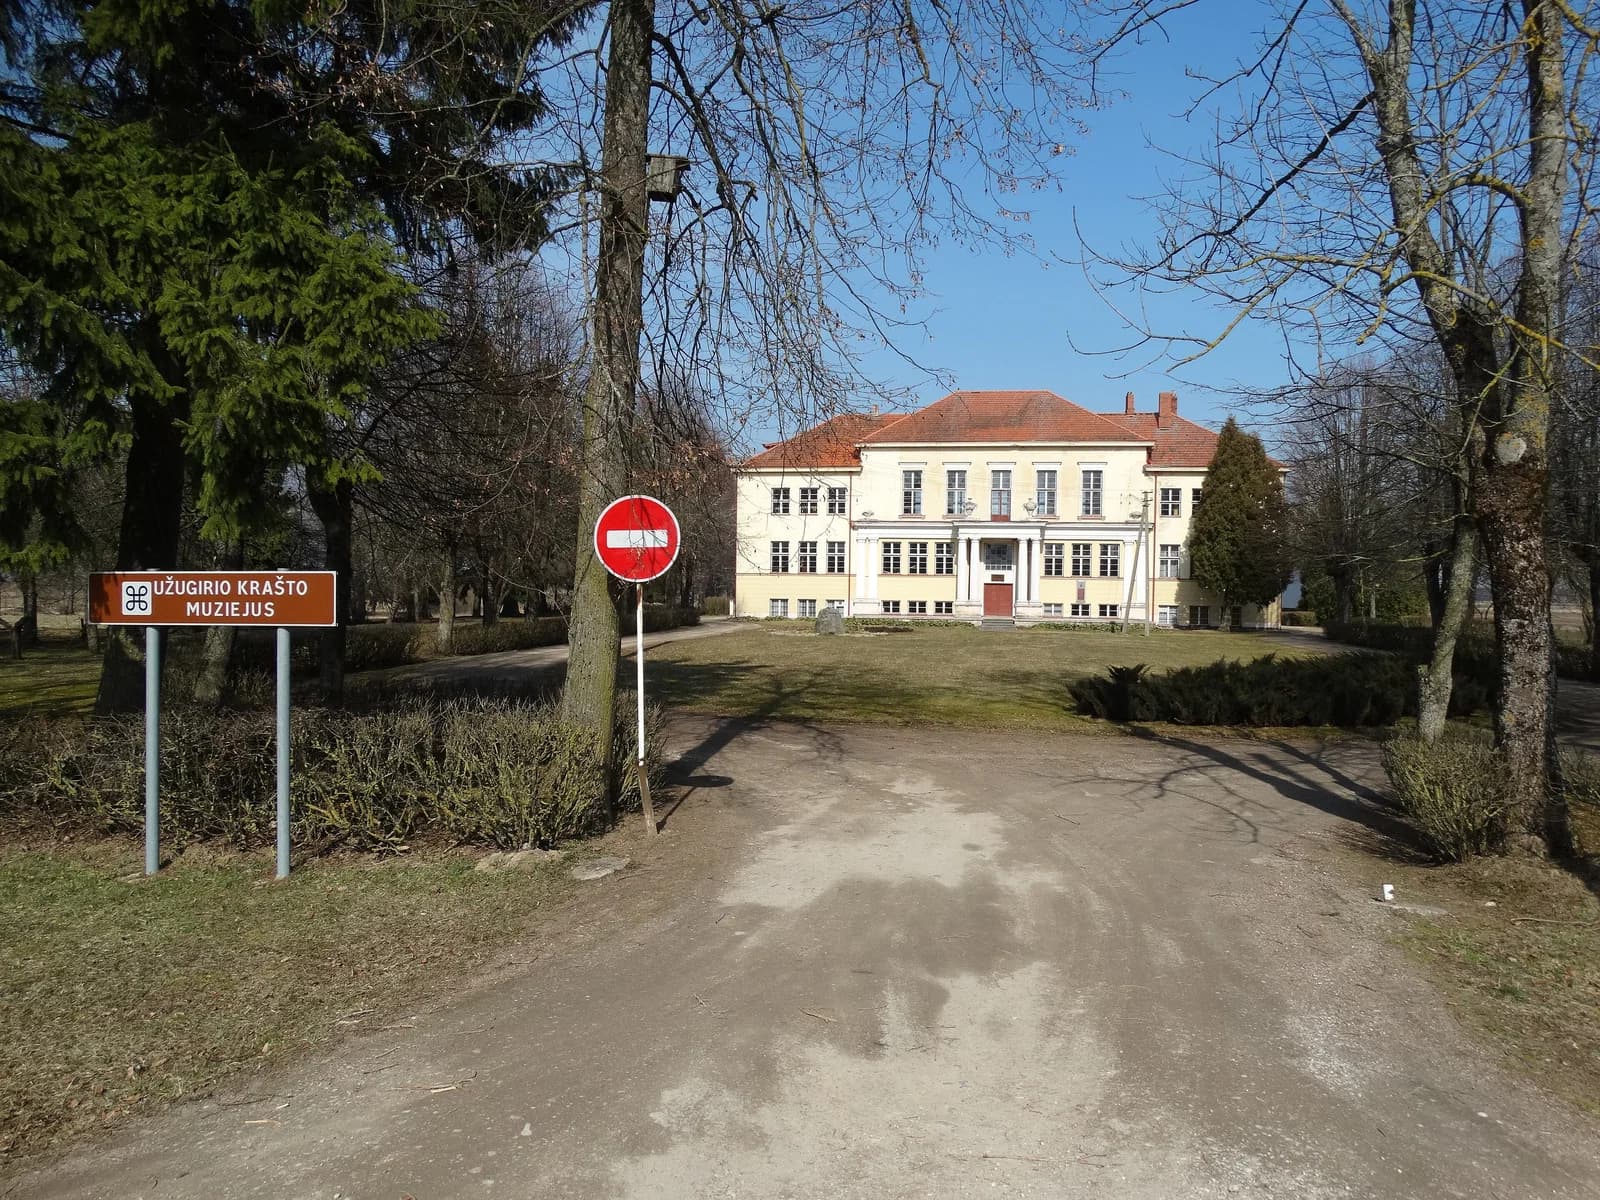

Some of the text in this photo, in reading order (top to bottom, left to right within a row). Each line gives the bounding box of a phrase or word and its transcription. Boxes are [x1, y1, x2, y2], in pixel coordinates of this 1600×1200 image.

[153, 576, 308, 596] UŽUGIRIO KRAŠTO
[186, 601, 275, 617] MUZIEJUS
